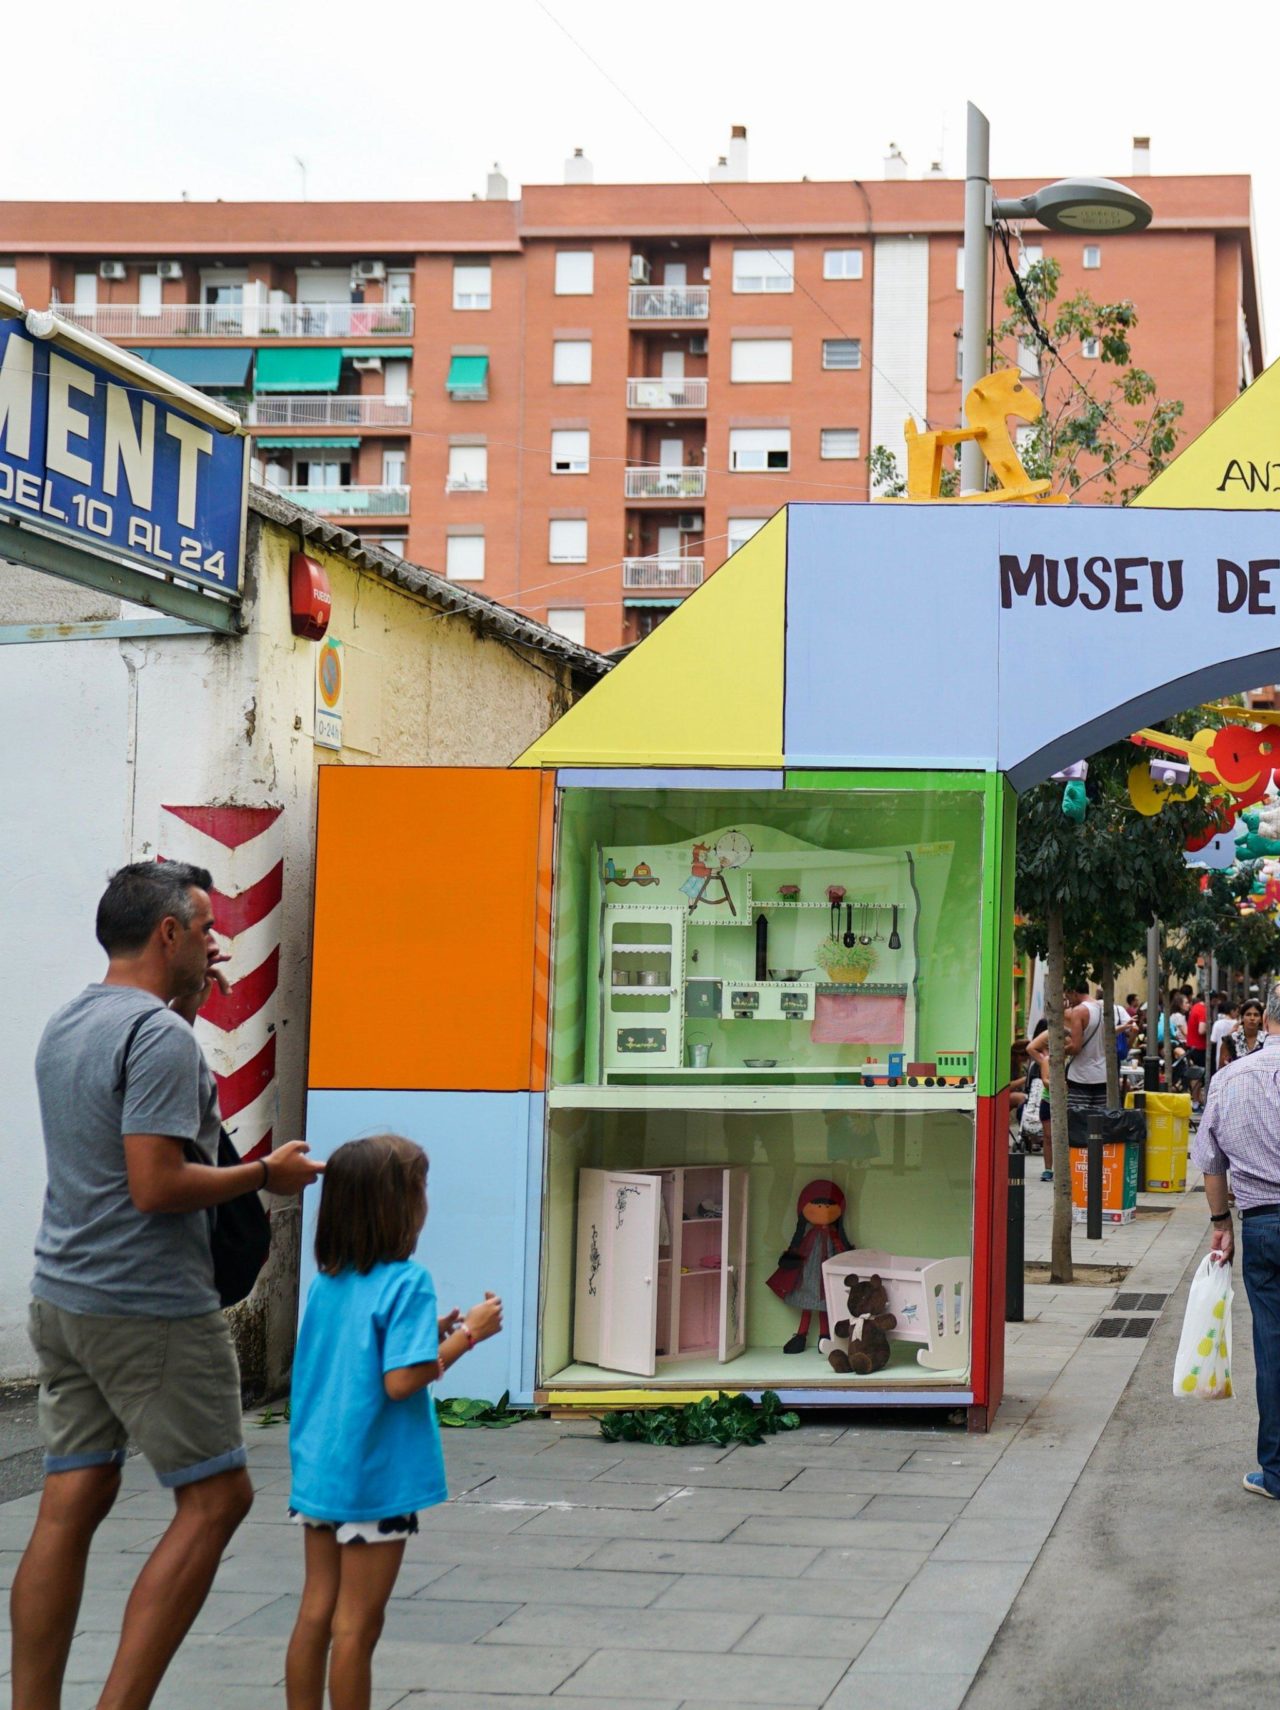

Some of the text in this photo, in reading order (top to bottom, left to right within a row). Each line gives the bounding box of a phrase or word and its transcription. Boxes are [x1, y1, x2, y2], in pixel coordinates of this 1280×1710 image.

[72, 494, 113, 537] 10
[128, 516, 172, 561] AL
[180, 536, 225, 581] 24
[313, 587, 332, 605] FUEGO
[1000, 554, 1184, 613] MUSEU
[1217, 558, 1280, 615] DE
[319, 721, 339, 739] 0-24h
